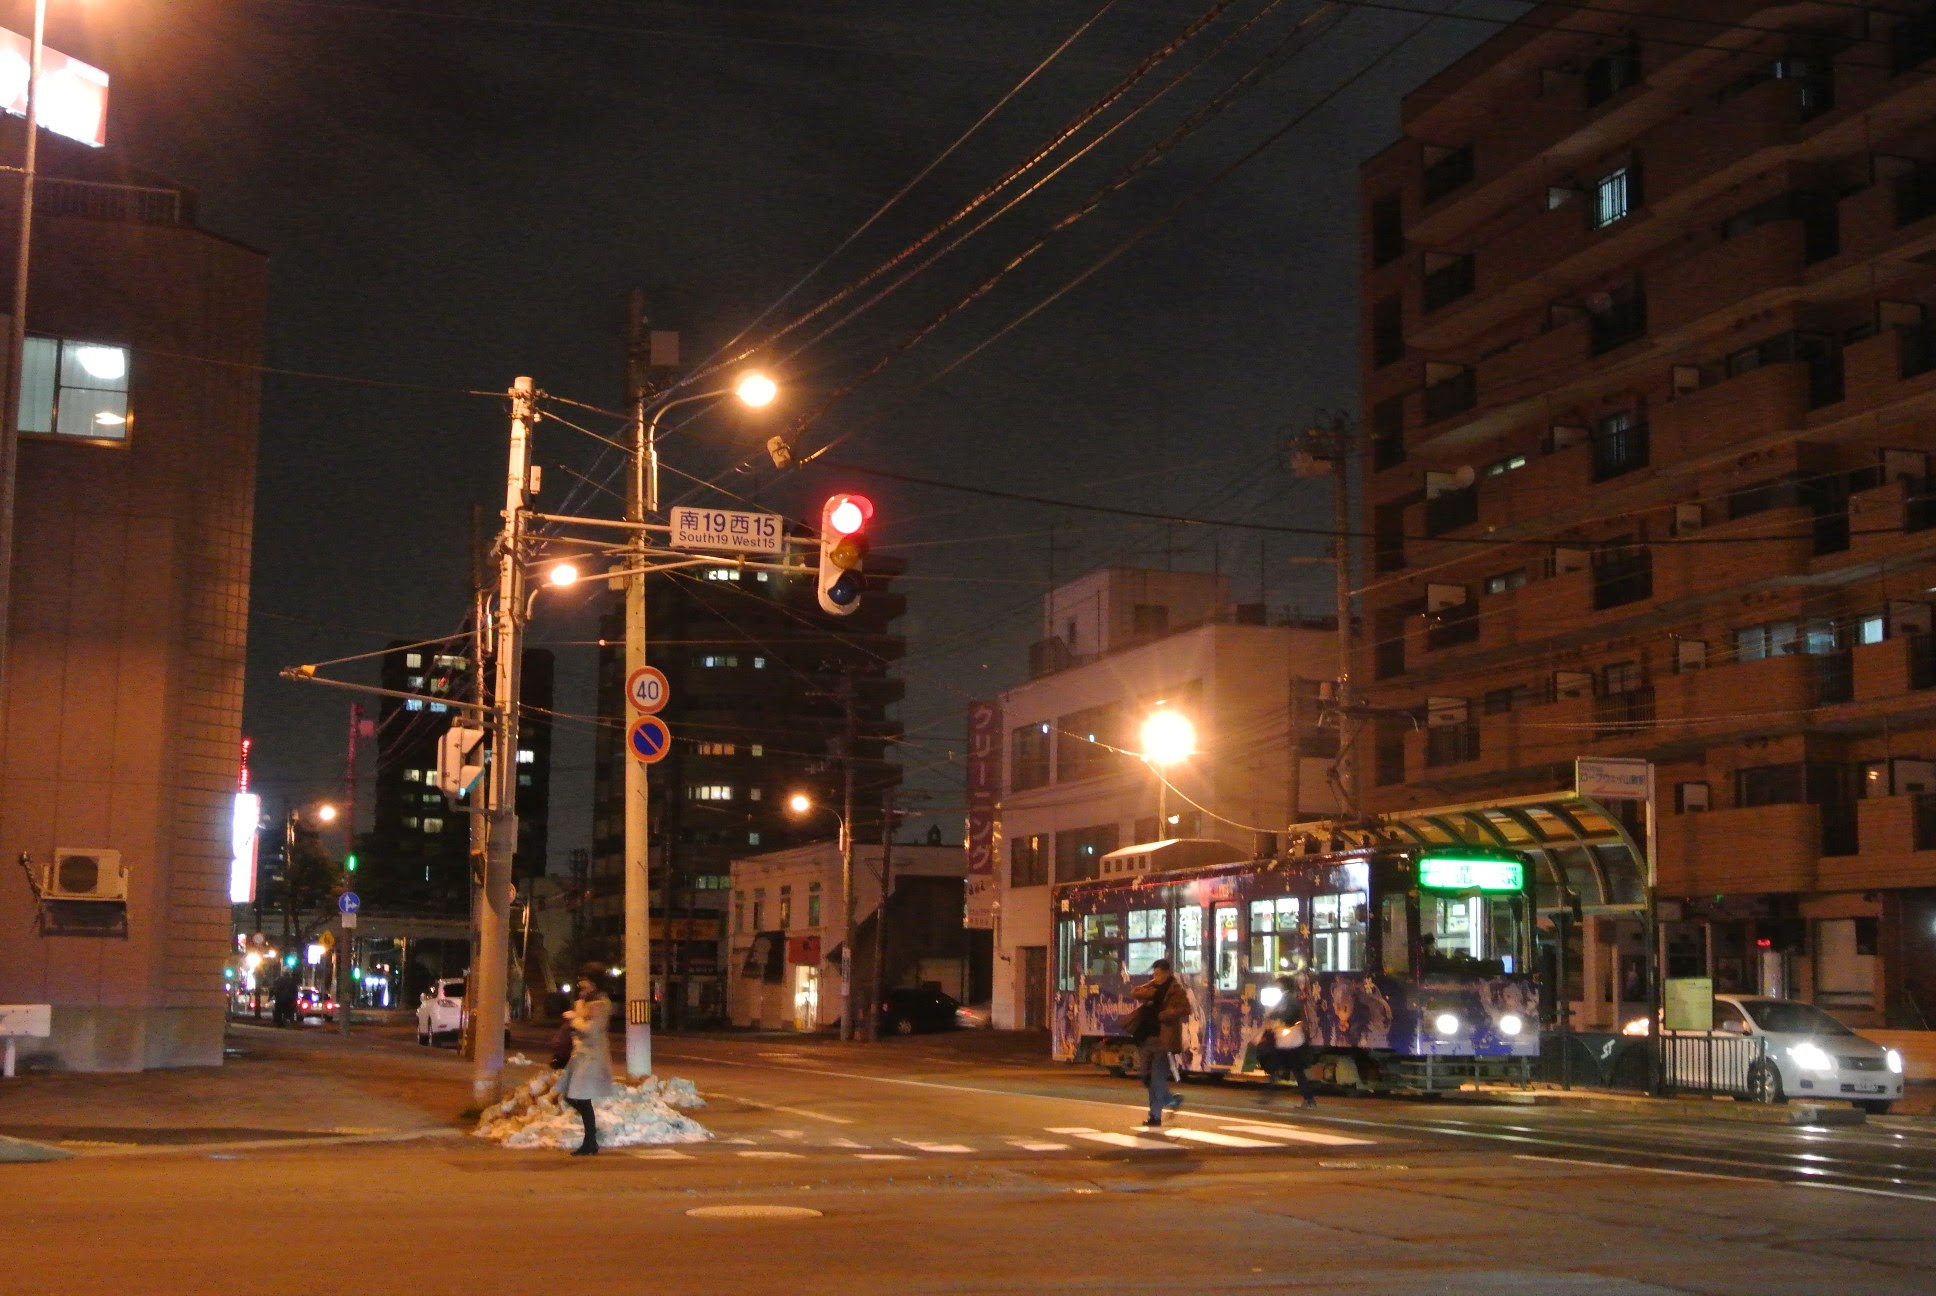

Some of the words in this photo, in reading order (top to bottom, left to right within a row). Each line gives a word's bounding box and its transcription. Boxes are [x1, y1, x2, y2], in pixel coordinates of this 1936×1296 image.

[680, 511, 775, 537] 南19西15
[637, 680, 659, 700] 40
[972, 709, 993, 870] クリーニング
